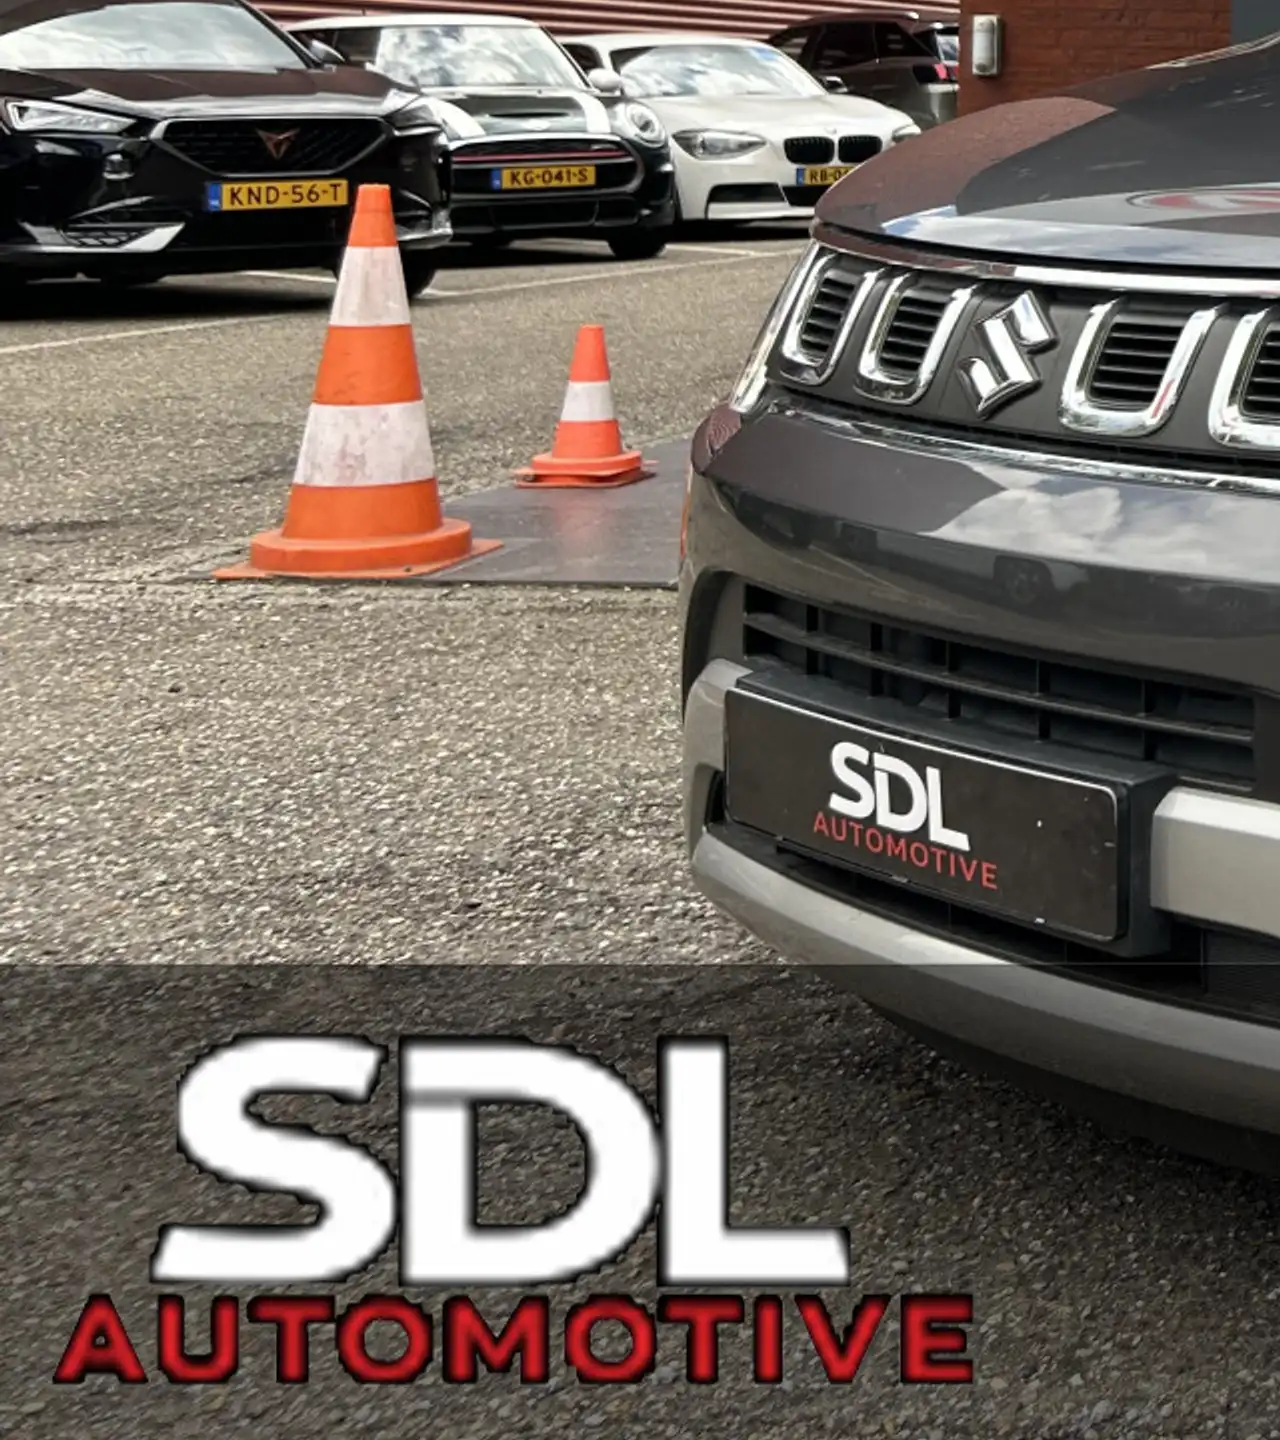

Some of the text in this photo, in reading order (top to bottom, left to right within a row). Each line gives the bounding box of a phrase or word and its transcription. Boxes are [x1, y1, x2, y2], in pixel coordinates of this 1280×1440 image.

[229, 183, 343, 207] KND-56-T
[509, 167, 589, 185] KG-041-S
[828, 741, 971, 851] SDL
[813, 811, 998, 890] AUTOMOTIVE
